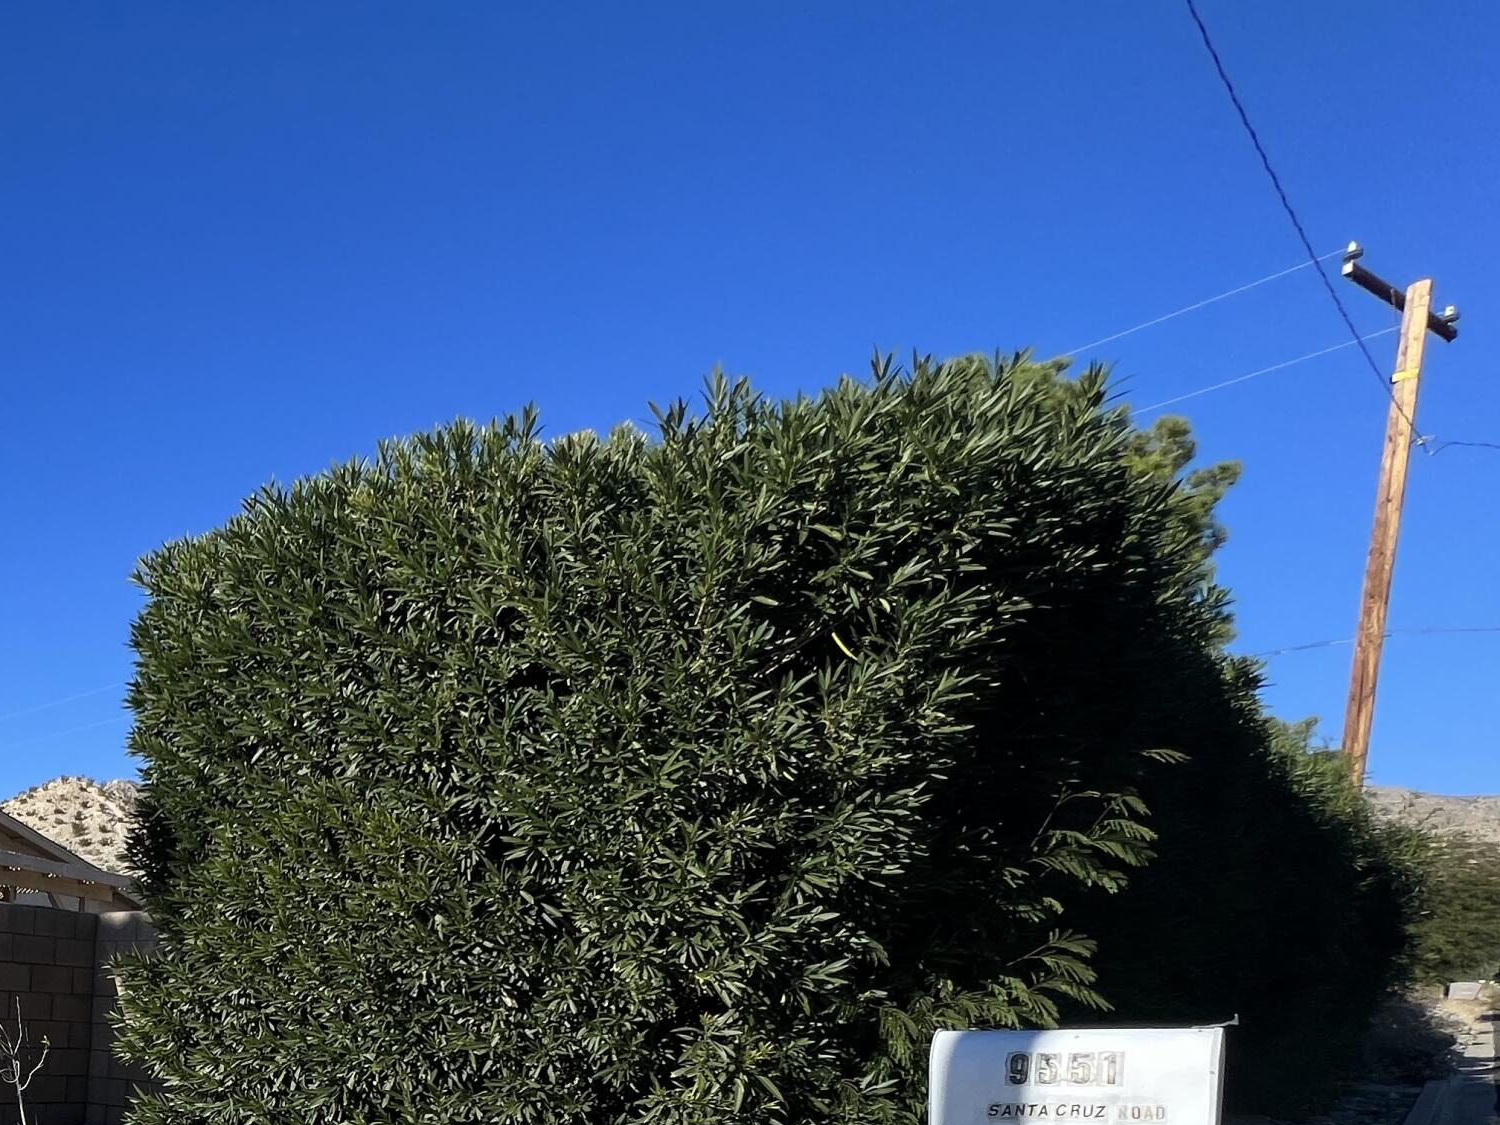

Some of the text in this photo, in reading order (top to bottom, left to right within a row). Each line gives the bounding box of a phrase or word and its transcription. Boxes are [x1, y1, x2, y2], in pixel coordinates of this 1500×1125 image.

[1009, 1052, 1118, 1085] 9551
[987, 1104, 1166, 1120] SANTA CRUZ ROAD
